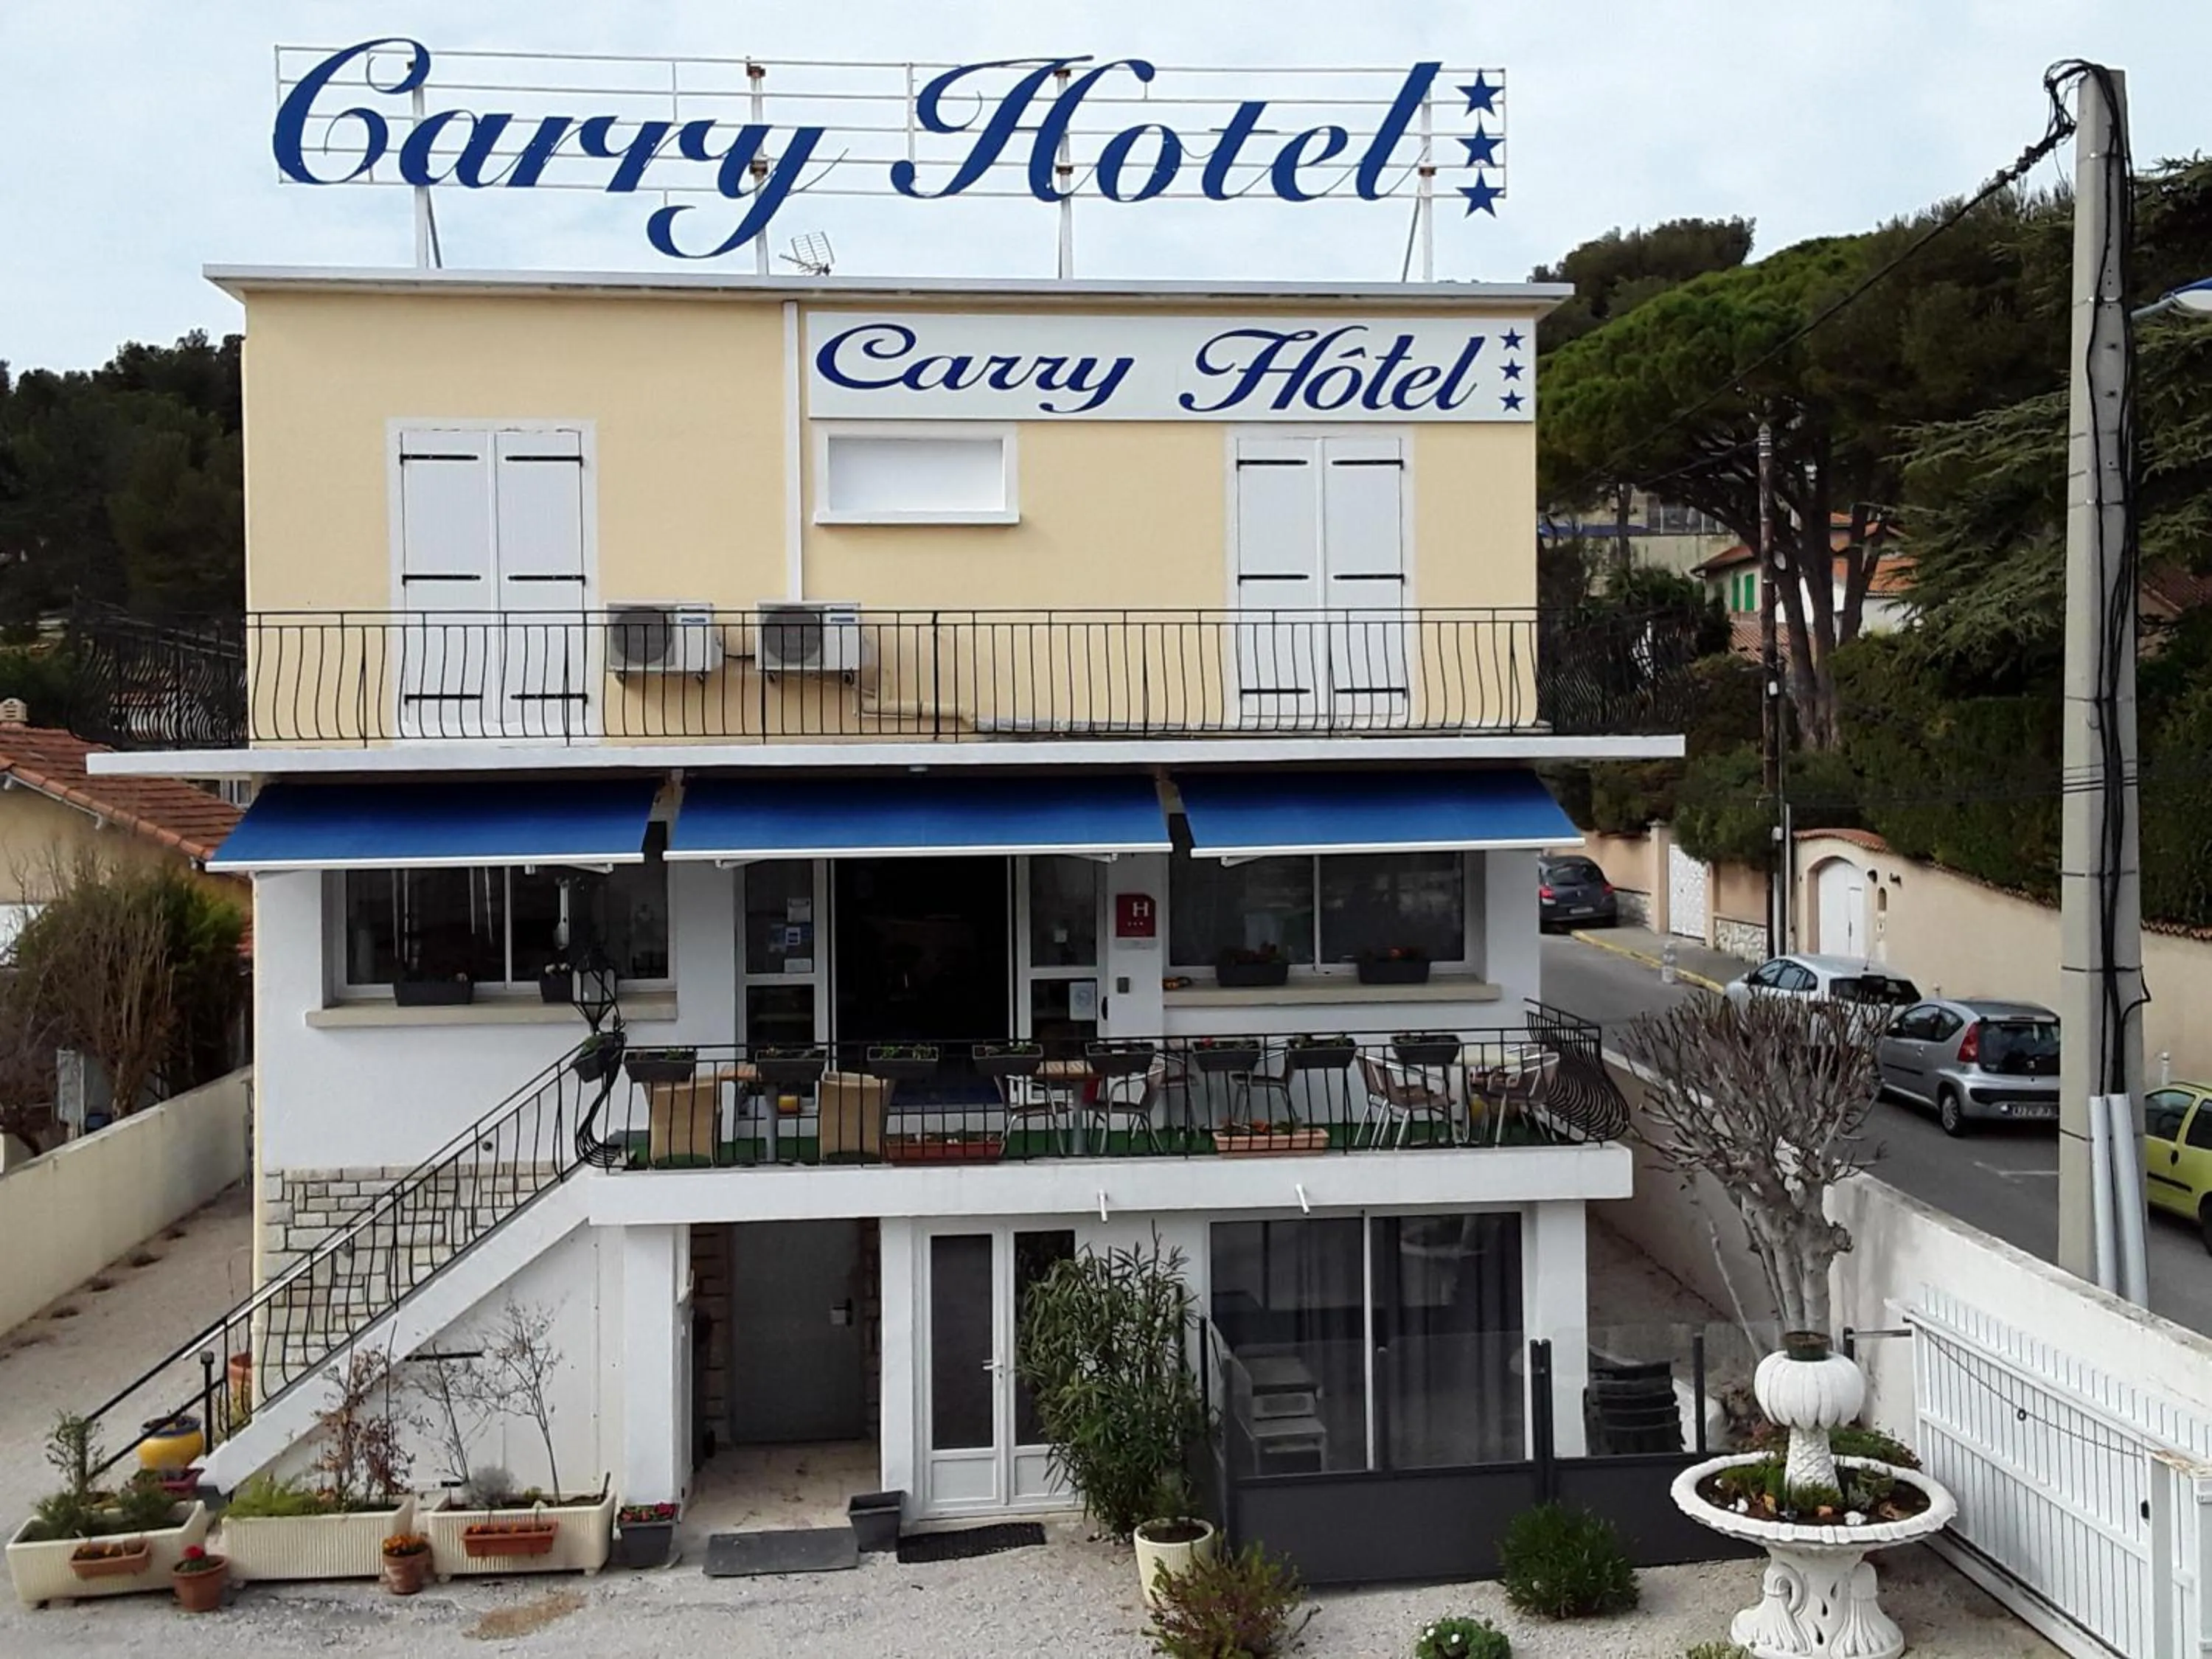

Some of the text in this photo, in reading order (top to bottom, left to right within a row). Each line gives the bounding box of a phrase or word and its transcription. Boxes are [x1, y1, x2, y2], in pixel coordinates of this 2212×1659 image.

[273, 37, 1442, 259] Carry Hotel
[815, 323, 1486, 414] Carry Hôtel
[1133, 902, 1149, 917] H
